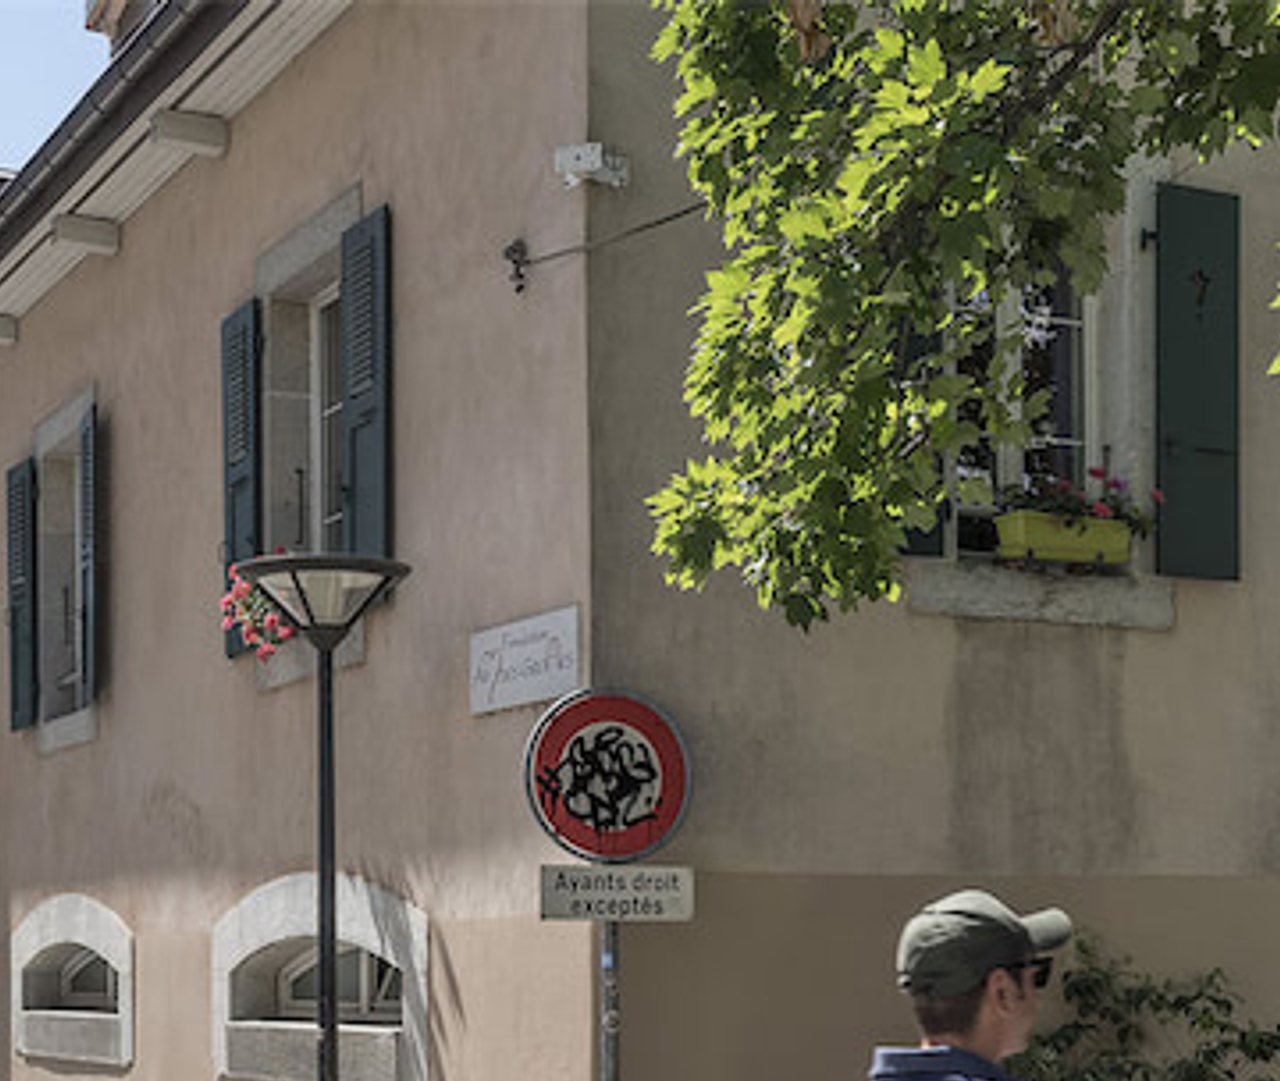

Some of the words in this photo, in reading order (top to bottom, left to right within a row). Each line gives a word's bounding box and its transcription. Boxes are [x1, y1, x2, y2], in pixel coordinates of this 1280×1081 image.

[554, 871, 627, 893] Ayants
[631, 871, 682, 891] droit
[570, 897, 664, 919] exceptés
